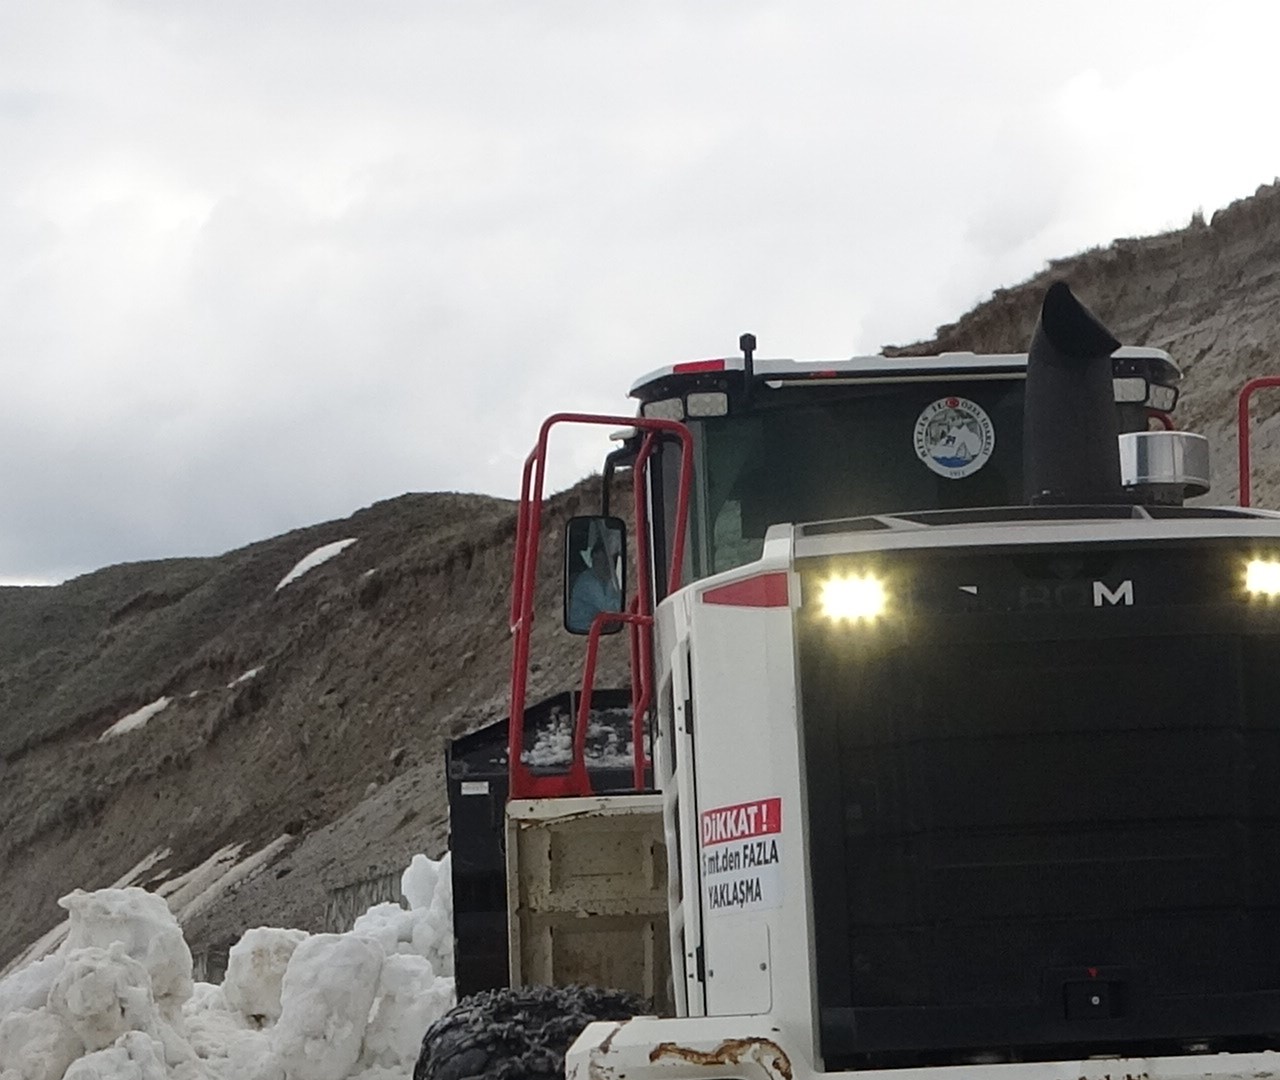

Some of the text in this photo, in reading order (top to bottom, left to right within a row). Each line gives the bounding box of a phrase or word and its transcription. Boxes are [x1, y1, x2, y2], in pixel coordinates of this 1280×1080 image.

[703, 805, 758, 844] DİKKAT
[708, 846, 741, 875] mt.den
[743, 839, 779, 869] FAZLA
[708, 877, 762, 910] YAKLAŞMA
